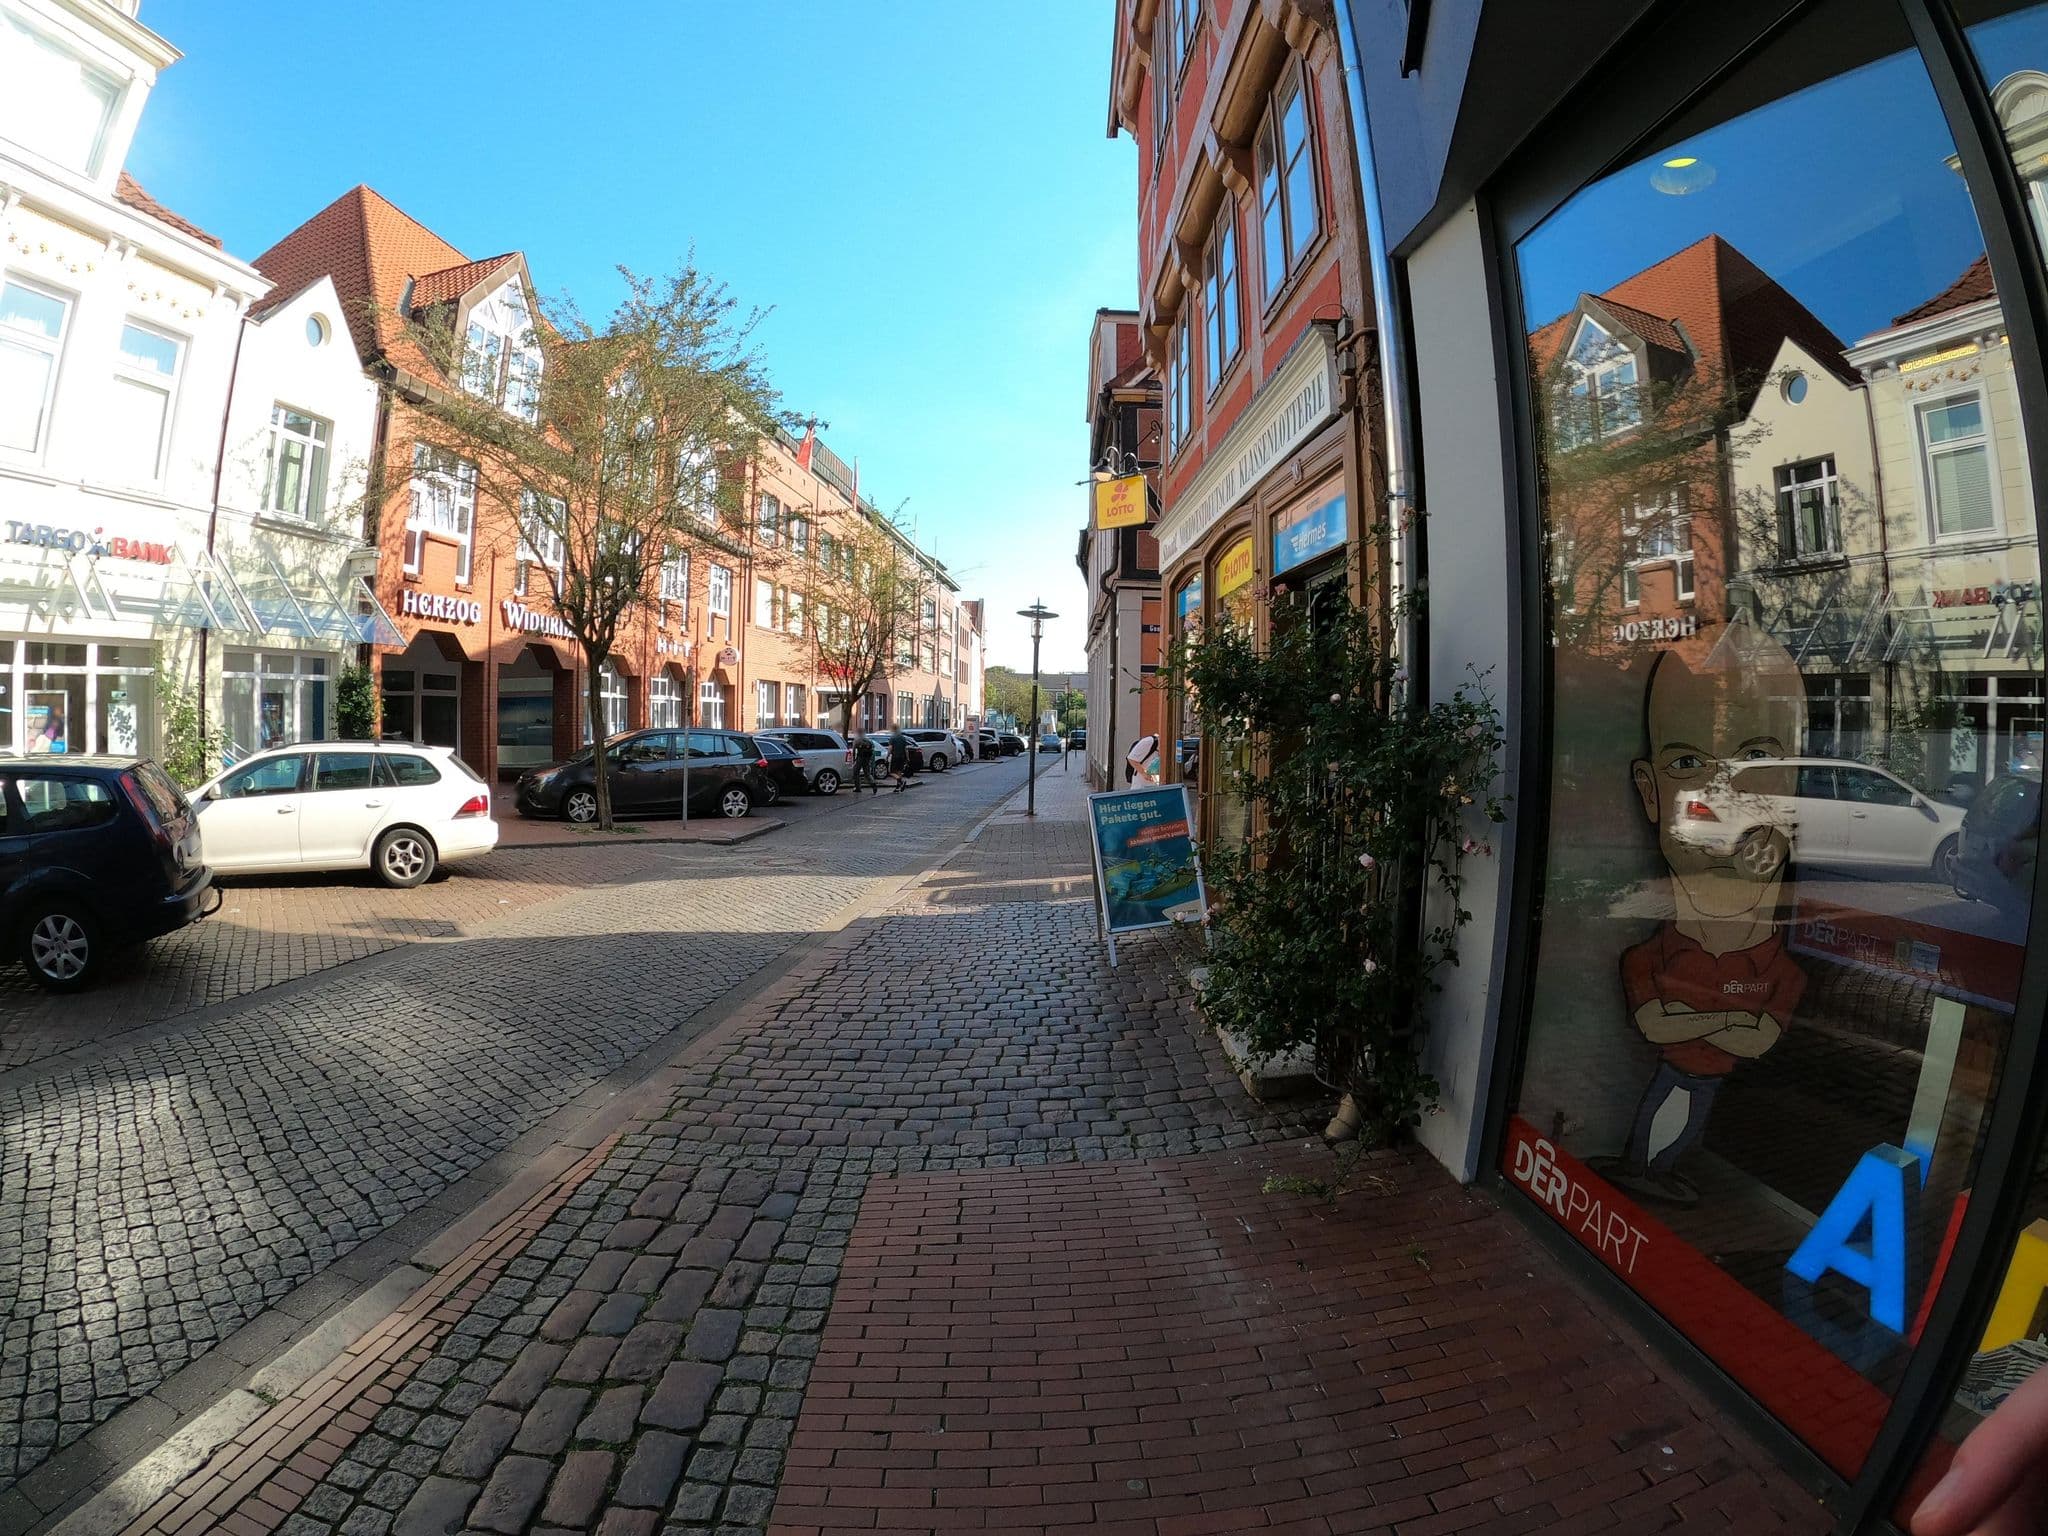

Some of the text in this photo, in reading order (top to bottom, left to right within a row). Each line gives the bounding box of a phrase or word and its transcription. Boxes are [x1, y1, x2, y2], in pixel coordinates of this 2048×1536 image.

[1238, 371, 1325, 488] KLASSENLOTTERIE
[1107, 504, 1135, 518] LOTTO
[1297, 521, 1326, 549] Hermes
[111, 537, 173, 565] BANK
[1230, 550, 1250, 578] LOTTO
[403, 588, 482, 624] HERZOG
[1099, 800, 1157, 814] Hier liegen
[1101, 810, 1162, 825] Pakete gut.
[1723, 980, 1770, 994] DERPART
[1514, 1138, 1650, 1274] DERPART
